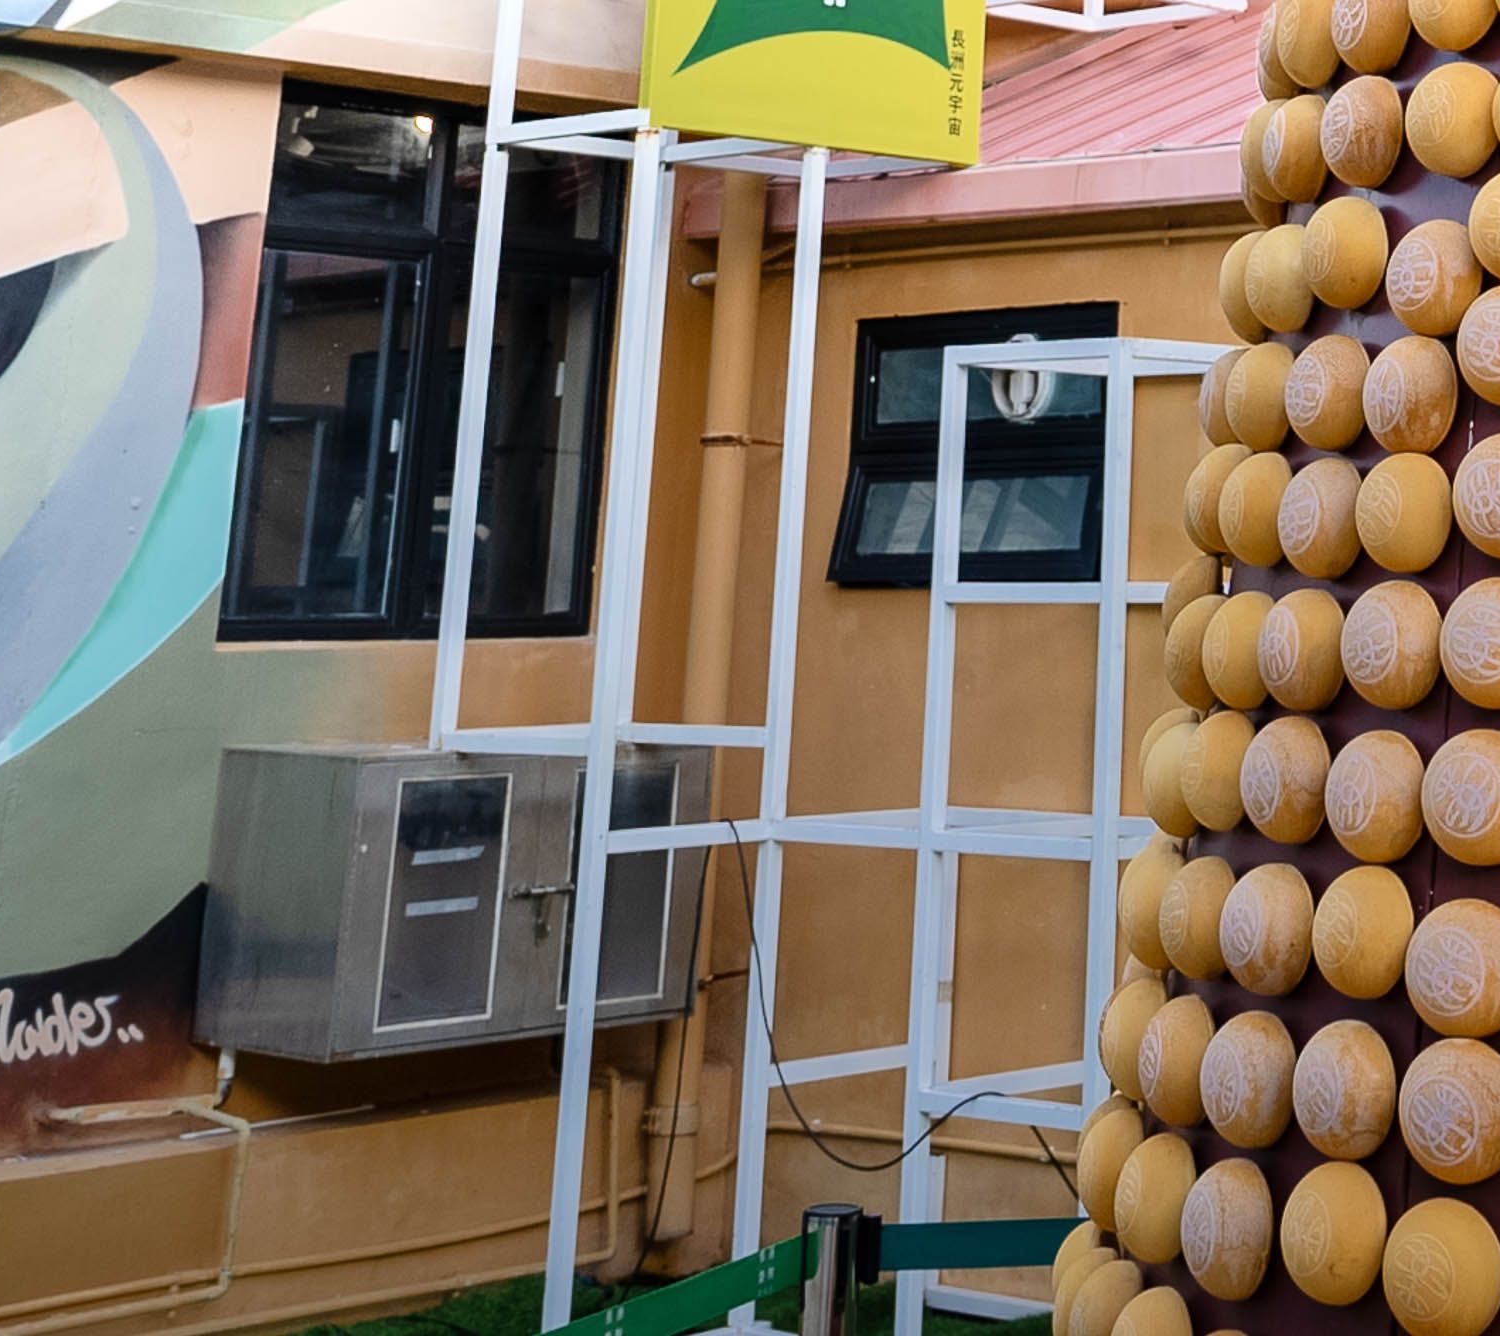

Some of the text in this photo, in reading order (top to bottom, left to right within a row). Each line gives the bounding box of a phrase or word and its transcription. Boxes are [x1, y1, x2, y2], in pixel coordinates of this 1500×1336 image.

[948, 29, 965, 136] 長洲元宇宙
